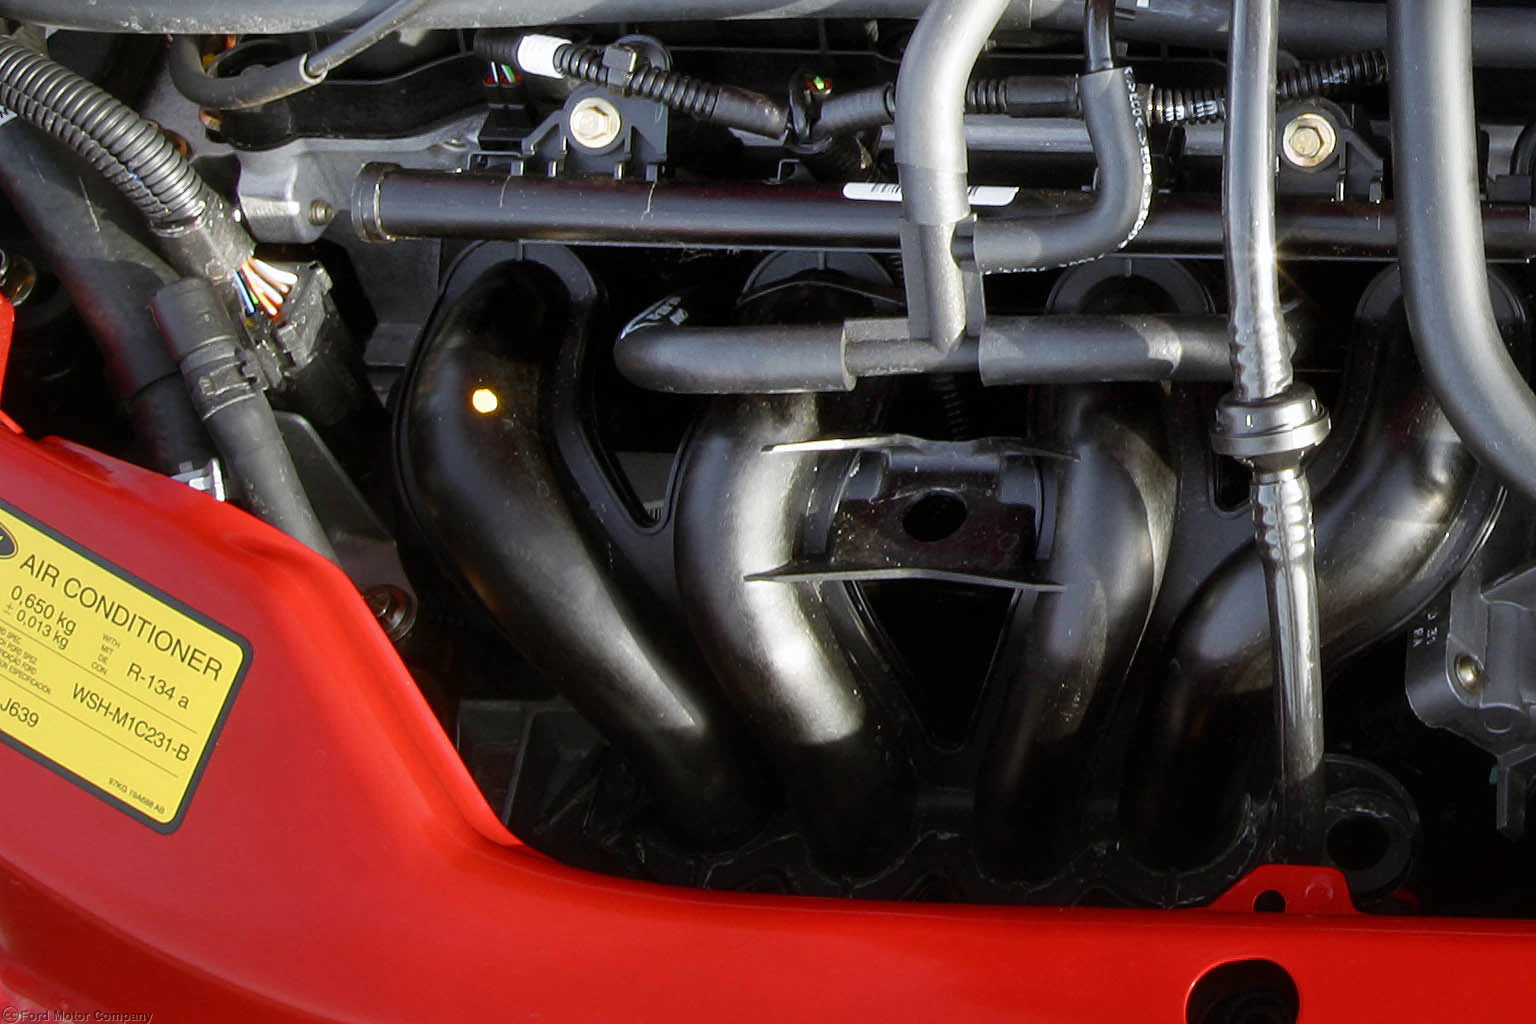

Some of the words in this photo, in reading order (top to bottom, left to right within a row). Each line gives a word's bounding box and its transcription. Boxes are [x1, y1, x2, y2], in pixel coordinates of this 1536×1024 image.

[10, 585, 56, 620] 0,650
[57, 611, 77, 637] kg
[16, 609, 52, 636] 0,013
[53, 631, 70, 651] kg
[19, 554, 60, 588] AIR
[63, 577, 223, 682] CONDITIONER
[126, 662, 176, 701] R-134
[178, 695, 190, 710] a
[72, 683, 191, 762] WSH-M1C231-B
